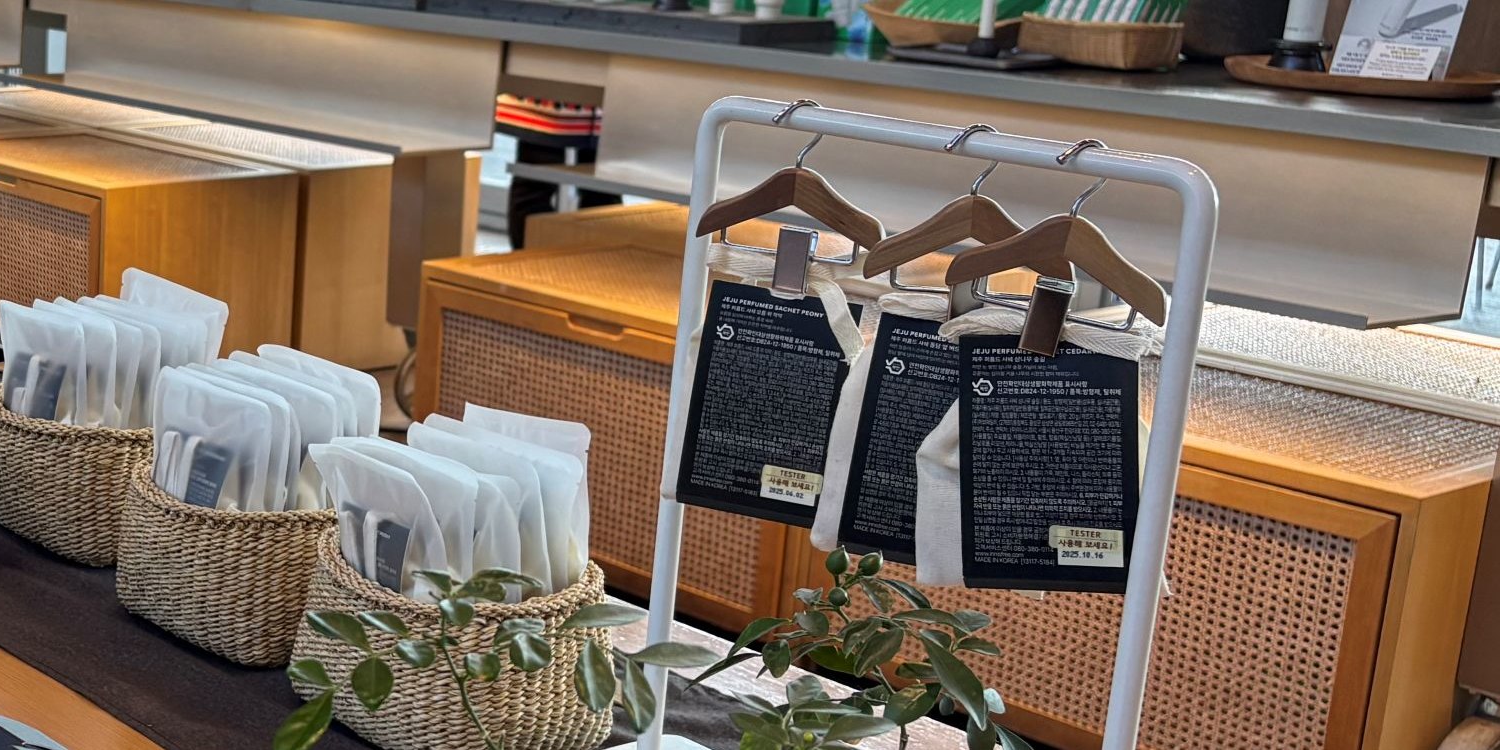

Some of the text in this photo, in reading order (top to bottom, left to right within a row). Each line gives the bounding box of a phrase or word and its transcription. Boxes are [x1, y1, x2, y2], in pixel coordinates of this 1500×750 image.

[722, 296, 824, 318] JEJU PERFUMED SACHET PEONY
[891, 328, 909, 336] JEJU
[780, 469, 806, 479] TESTER
[1070, 529, 1101, 538] TESTER
